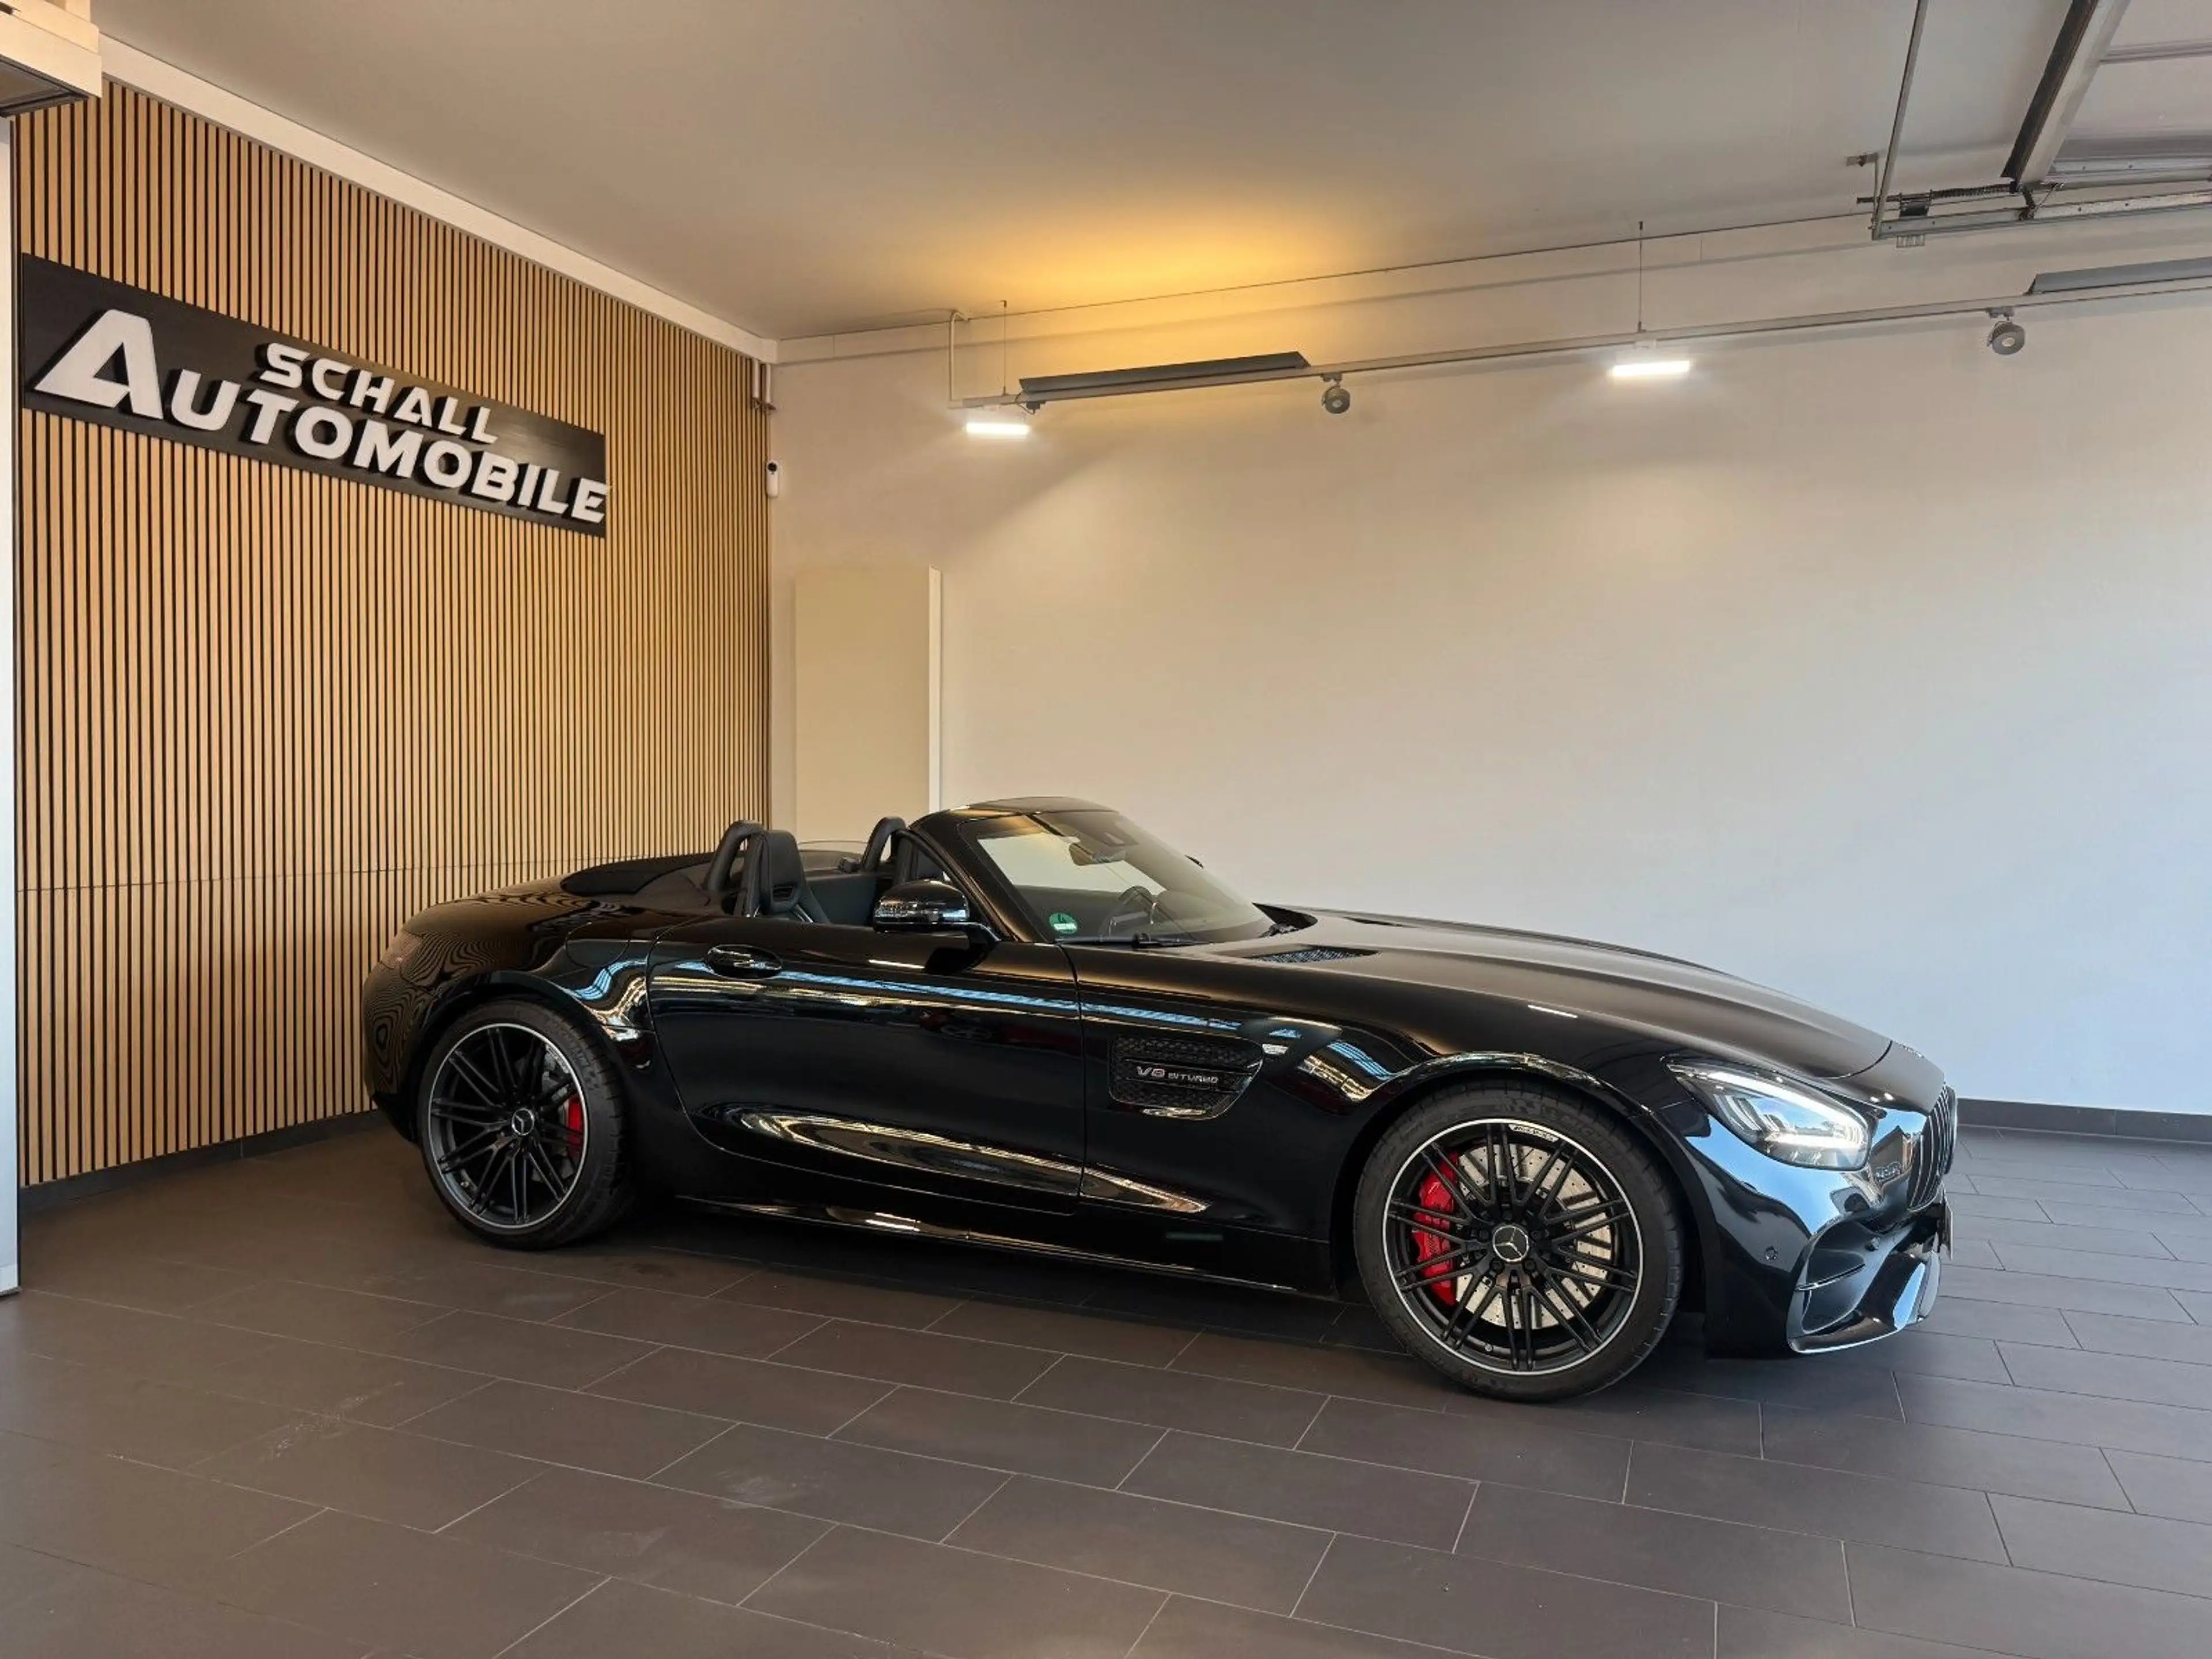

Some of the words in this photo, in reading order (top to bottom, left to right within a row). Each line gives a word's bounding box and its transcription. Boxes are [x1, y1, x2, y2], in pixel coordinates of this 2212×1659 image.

[34, 309, 609, 523] AUTOMOBILE
[260, 342, 498, 444] SCHALL
[1137, 1066, 1165, 1078] V8
